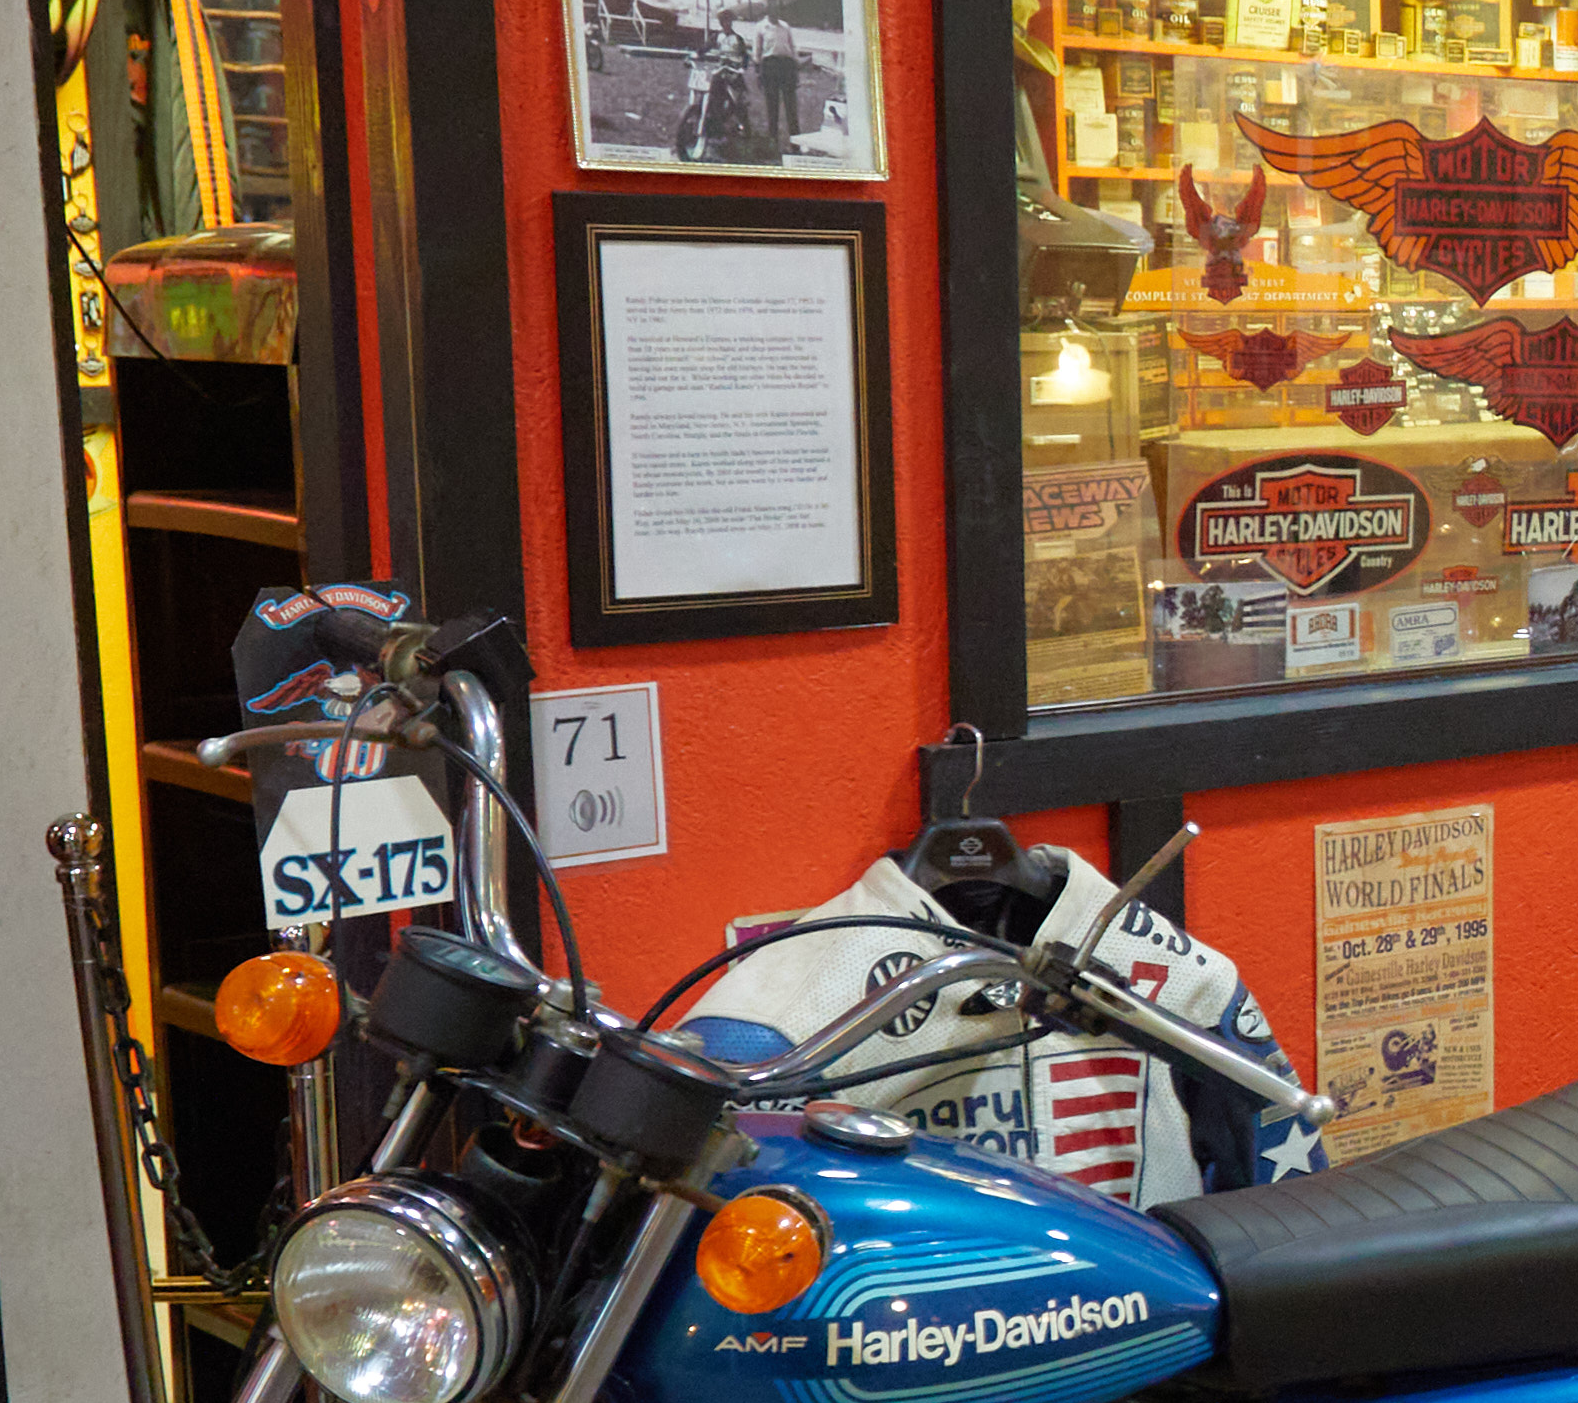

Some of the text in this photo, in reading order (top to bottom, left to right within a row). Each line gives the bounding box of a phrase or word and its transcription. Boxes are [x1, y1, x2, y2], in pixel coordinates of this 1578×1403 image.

[1169, 13, 1191, 25] OIL
[1433, 142, 1532, 183] MOTOR
[1403, 199, 1558, 226] HARLEY-DAVIDSON
[1433, 237, 1524, 267] CYCLES
[1125, 291, 1339, 302] COMPLETE DEPARTMENT
[1330, 386, 1404, 405] HARLEY-DAVIDSON
[1022, 476, 1145, 508] ACEWAY
[1221, 484, 1242, 499] This
[1277, 483, 1339, 506] MOTOR
[1208, 508, 1403, 546] HARLEY-DAVIDSON
[1395, 614, 1430, 627] AMRA
[551, 712, 628, 766] 71
[1324, 817, 1485, 876] HARLEY DAVIDSON
[272, 834, 449, 918] SX-175
[1325, 856, 1485, 908] WORLD FINALS
[1342, 939, 1372, 959] Oct.
[1405, 930, 1417, 948] &
[1455, 918, 1489, 941] 1995
[713, 1334, 810, 1355] AMF
[826, 1290, 1149, 1368] Harley-Davidson
